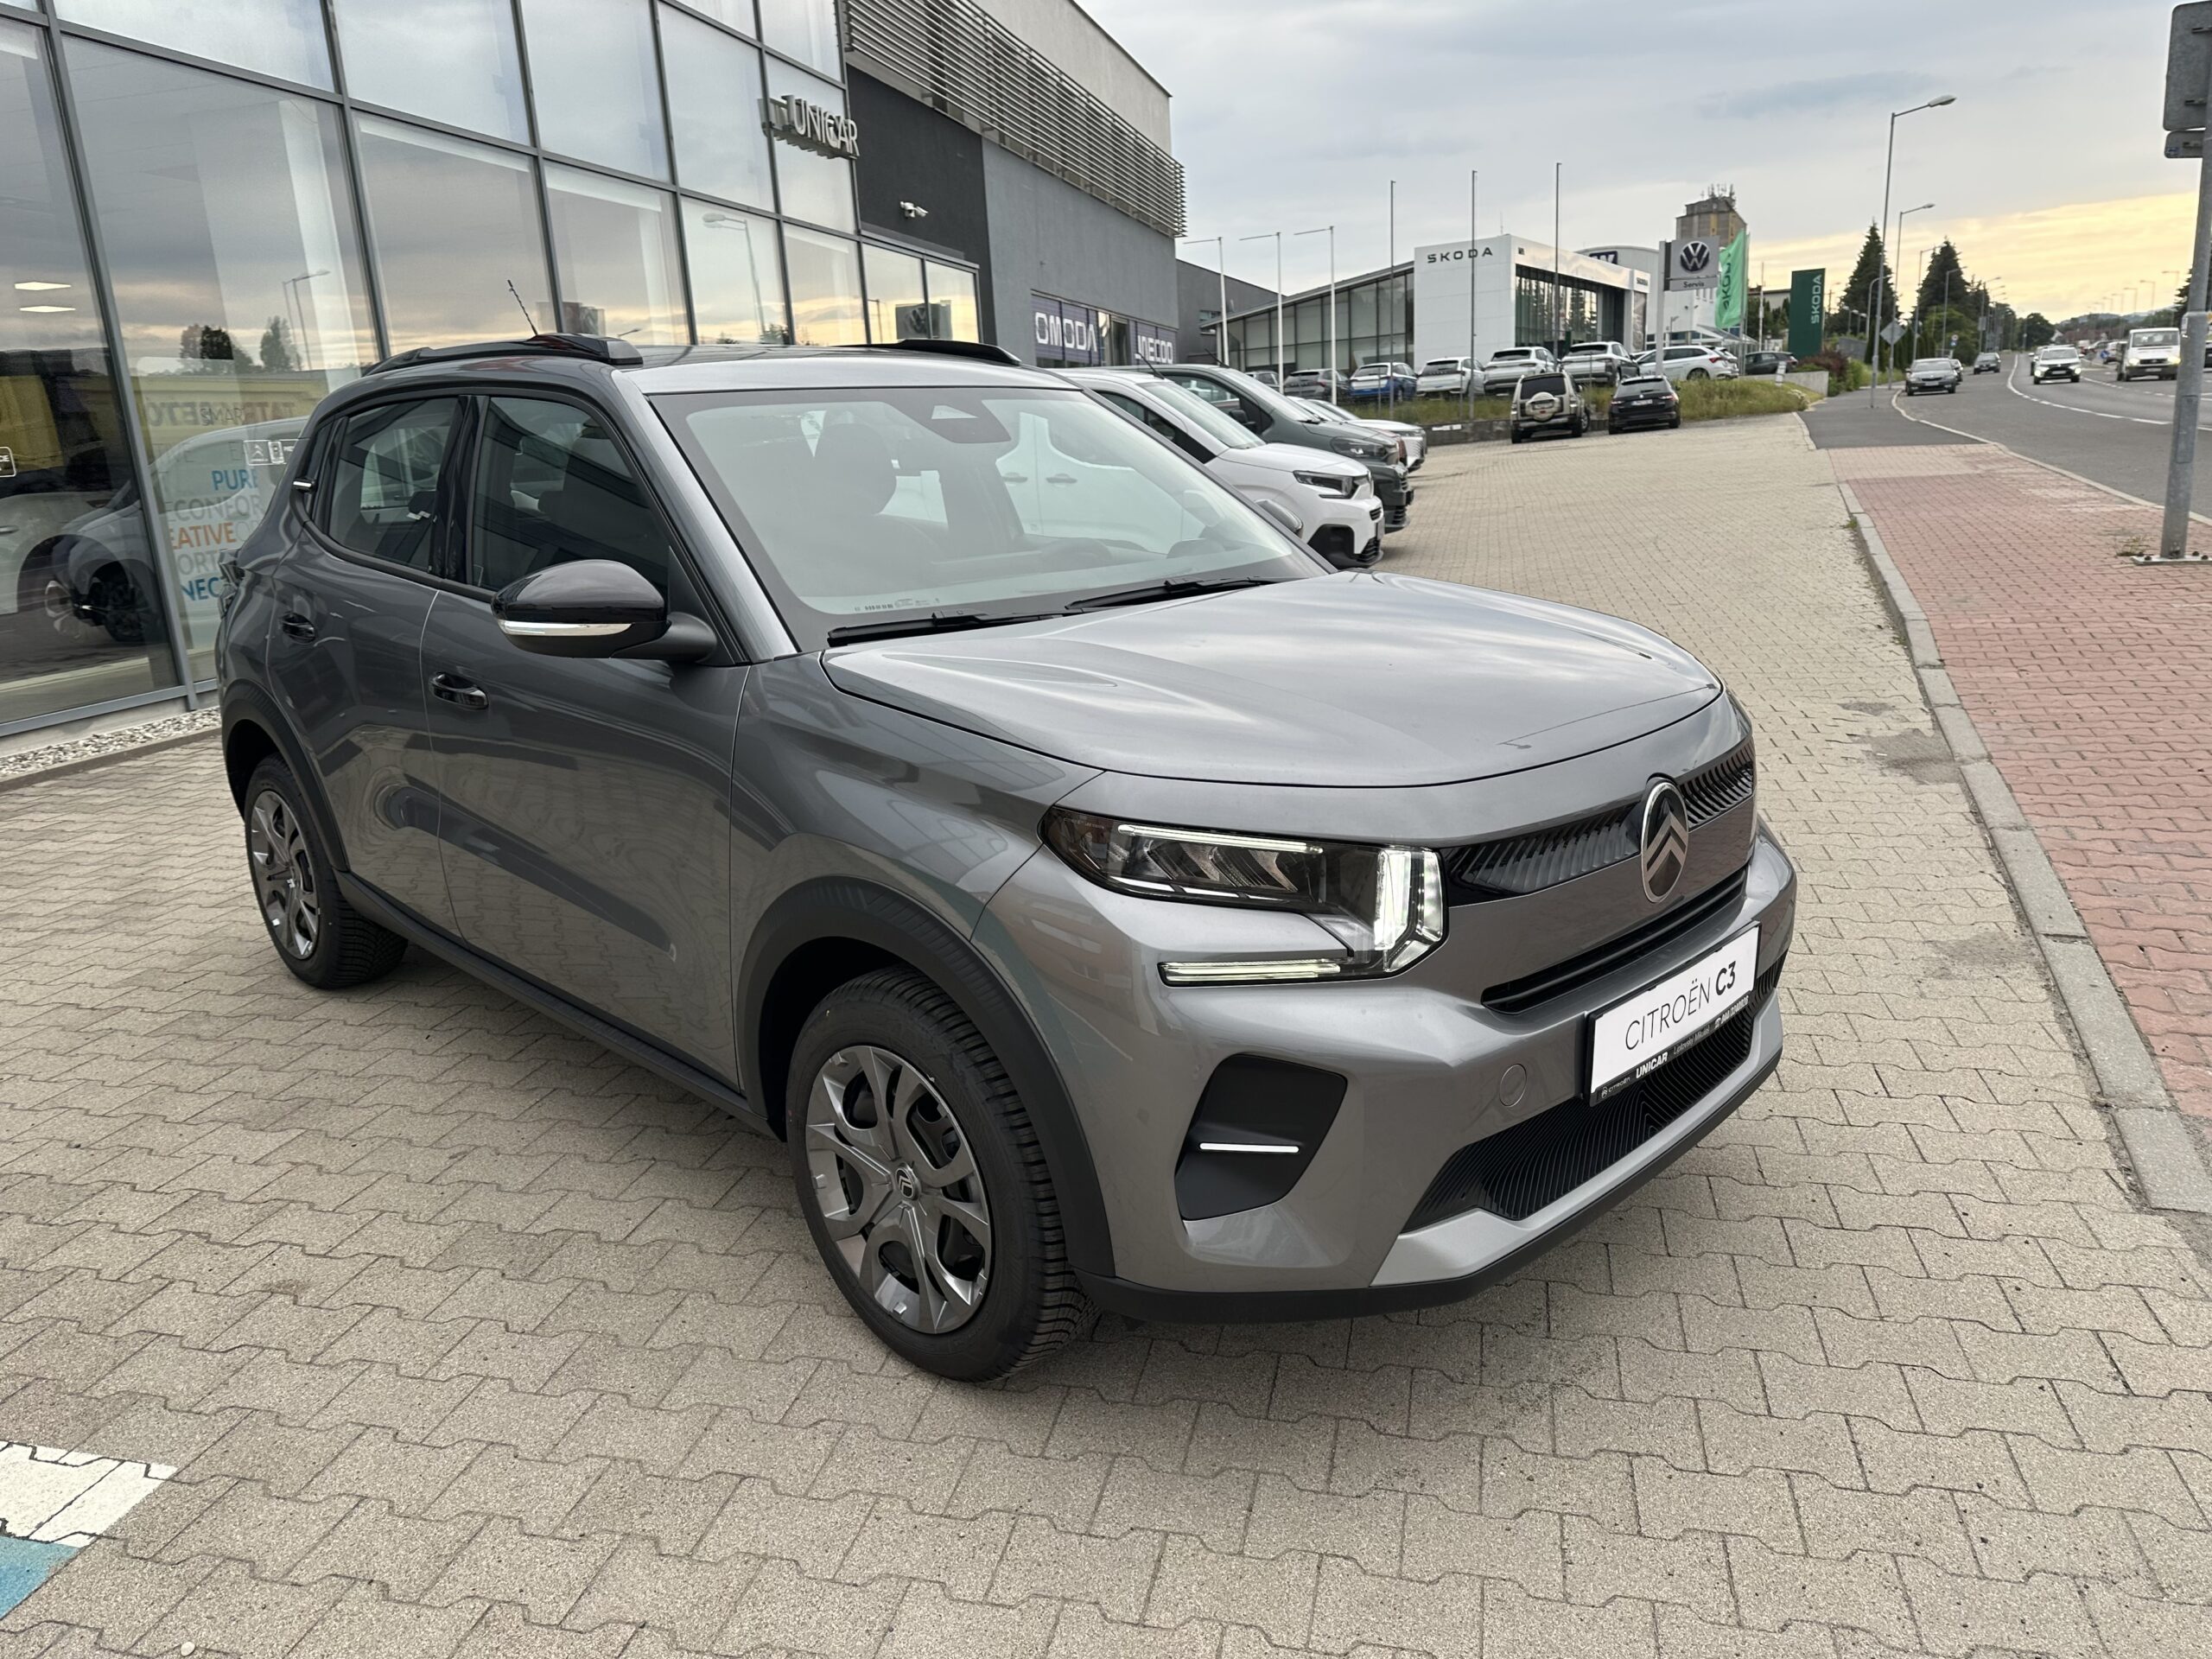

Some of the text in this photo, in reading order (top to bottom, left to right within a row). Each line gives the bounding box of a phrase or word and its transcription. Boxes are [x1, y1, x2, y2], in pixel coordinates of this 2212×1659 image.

[793, 97, 860, 157] UNICAR
[1034, 311, 1097, 353] OMODA
[1625, 977, 1711, 1051] CITROËN
[1715, 960, 1737, 996] C3
[1636, 1051, 1669, 1079] UNICAR
